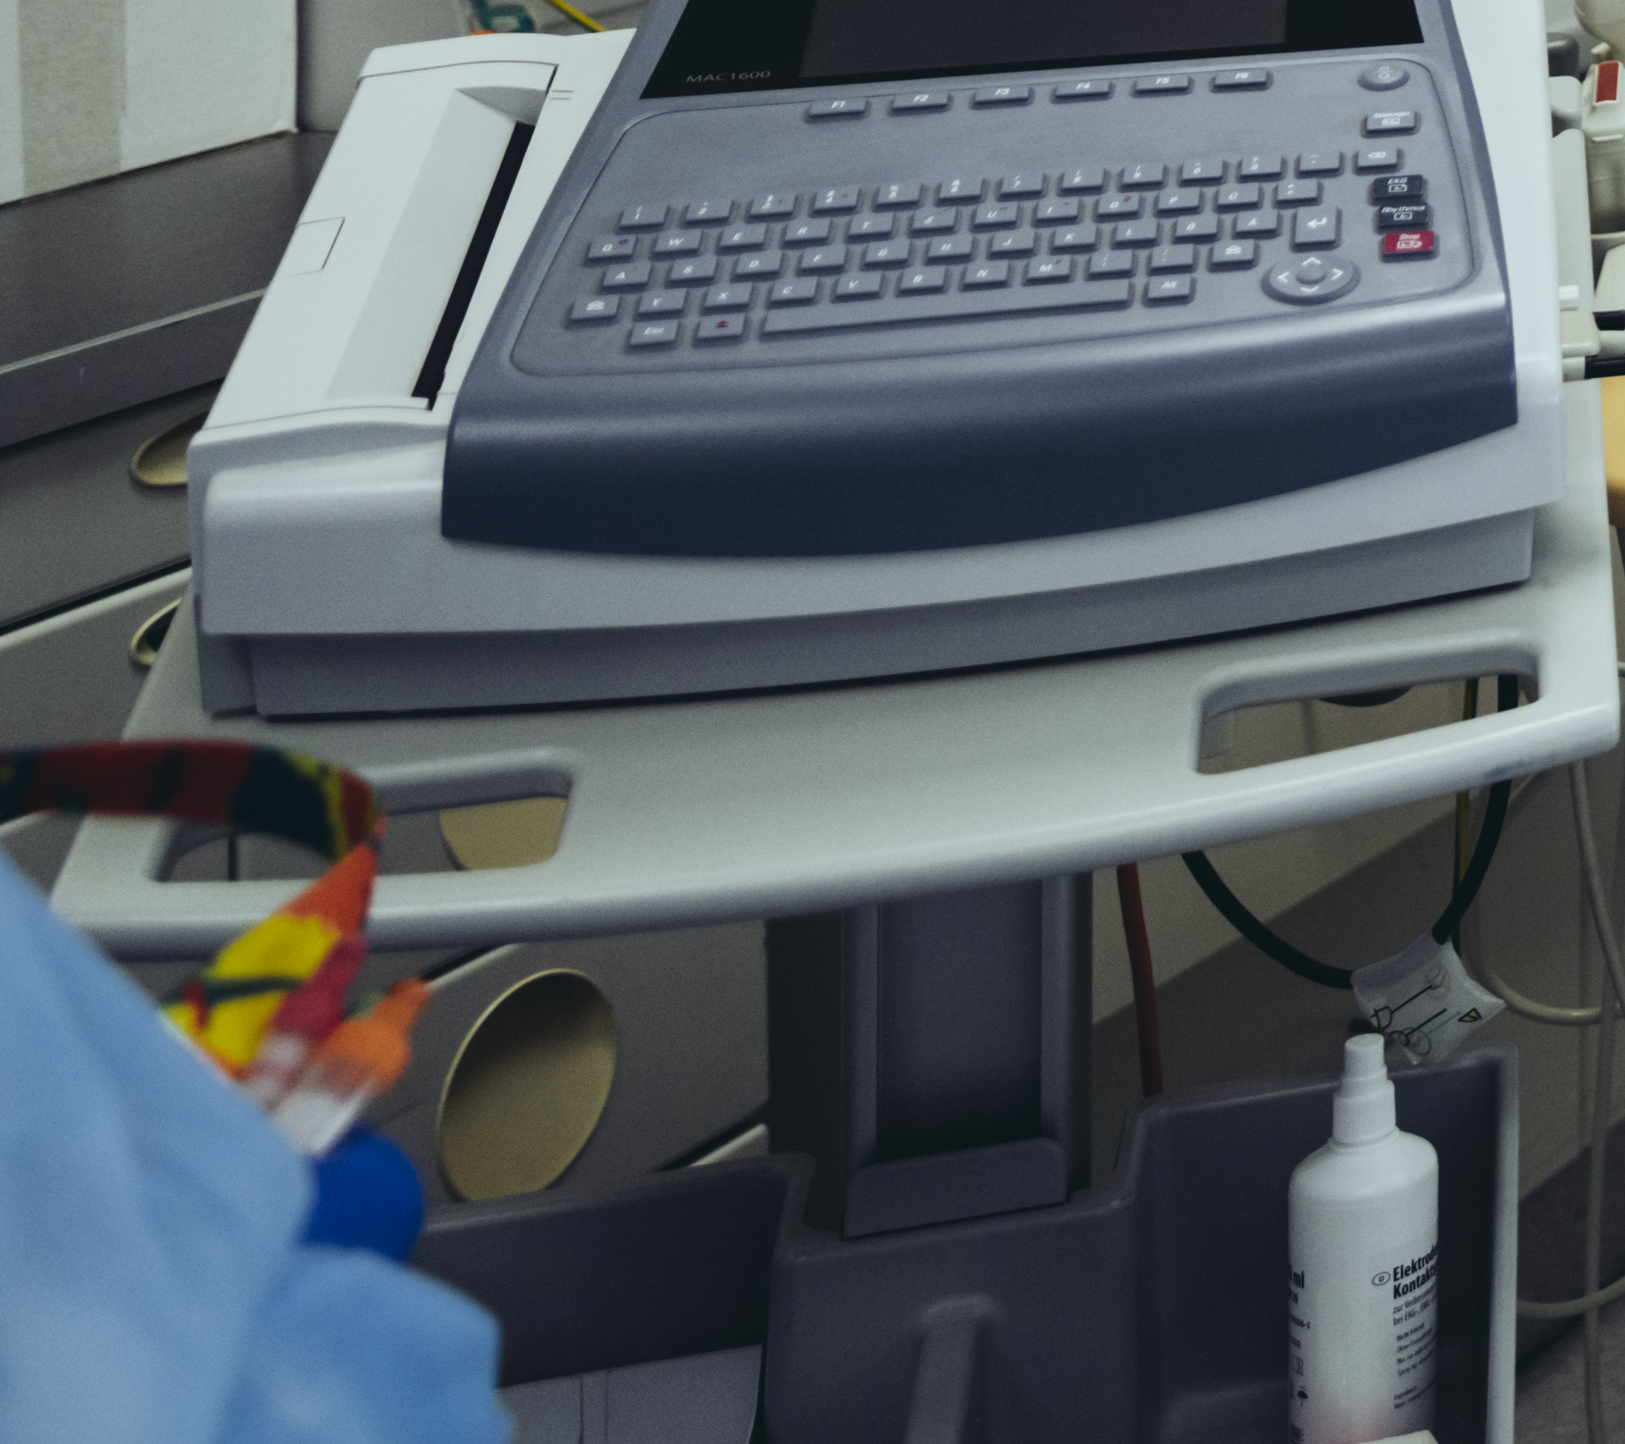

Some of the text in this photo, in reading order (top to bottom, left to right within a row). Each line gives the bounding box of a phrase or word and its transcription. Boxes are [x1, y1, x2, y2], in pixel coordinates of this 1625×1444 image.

[831, 100, 847, 109] F1
[913, 94, 929, 102] F2
[994, 87, 1010, 96] F3
[1076, 81, 1092, 90] F4
[1155, 76, 1171, 85] F5
[1387, 177, 1408, 185] EKG
[1381, 204, 1426, 214] Rhythmus
[668, 237, 684, 247] W
[732, 232, 743, 242] E
[987, 210, 998, 218] U
[1399, 232, 1421, 241] Stop
[977, 268, 989, 277] N
[1038, 263, 1053, 273] M
[615, 271, 626, 281] A
[643, 326, 666, 335] Esc
